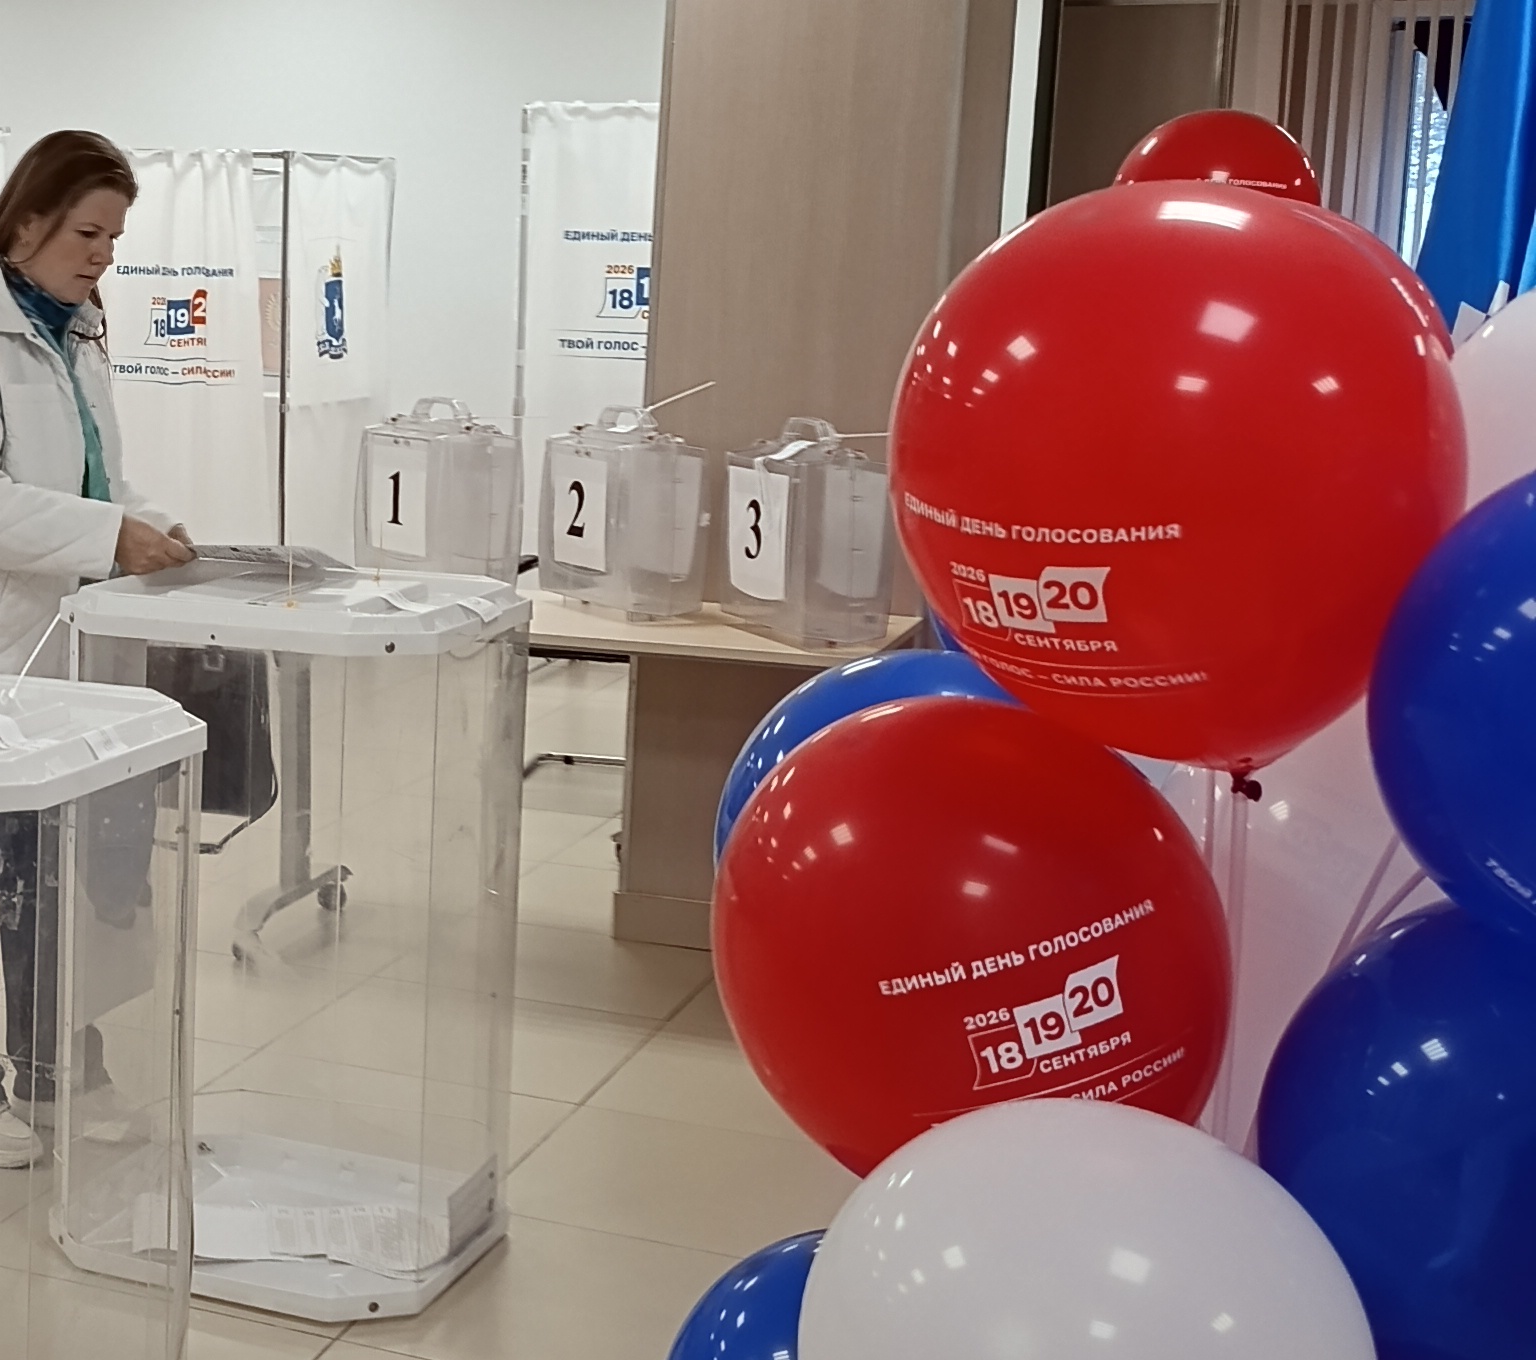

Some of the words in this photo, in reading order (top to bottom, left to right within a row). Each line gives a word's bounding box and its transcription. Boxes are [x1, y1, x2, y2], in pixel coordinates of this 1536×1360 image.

[564, 229, 619, 242] ЕДИНЫЙ
[116, 264, 161, 276] ЕДИНЫЙ
[605, 264, 635, 275] 2026
[608, 288, 634, 309] 18
[153, 318, 166, 338] 18
[168, 308, 189, 328] 19
[558, 337, 594, 350] ТВОЙ
[597, 340, 639, 351] ГОЛОС
[113, 362, 143, 374] ТВОЙ
[387, 471, 404, 526] 1
[566, 480, 586, 538] 2
[744, 499, 762, 560] 3
[904, 492, 956, 528] ЕДИНЫЙ
[960, 516, 1007, 539] ДЕНЬ
[1011, 523, 1182, 544] ГОЛОСОВАНИЯ
[949, 561, 986, 583] 2026
[962, 596, 1000, 629] 18
[997, 590, 1038, 621] 19
[1042, 580, 1099, 611] 20
[1014, 632, 1119, 653] СЕНТЯБРЯ
[1051, 673, 1107, 688] СИЛА
[1109, 670, 1210, 688] РОССИИ!
[878, 961, 966, 996] ЕДИНЫЙ
[971, 950, 1025, 980] ДЕНЬ
[1027, 898, 1155, 961] ГОЛОСОВАНИЯ
[963, 1007, 1011, 1031] 2026
[979, 1040, 1024, 1074] 18
[1023, 1011, 1065, 1045] 19
[1067, 976, 1115, 1019] 20
[1039, 1031, 1132, 1074] СЕНТЯБРЯ
[1121, 1046, 1185, 1088] РОССИИ!
